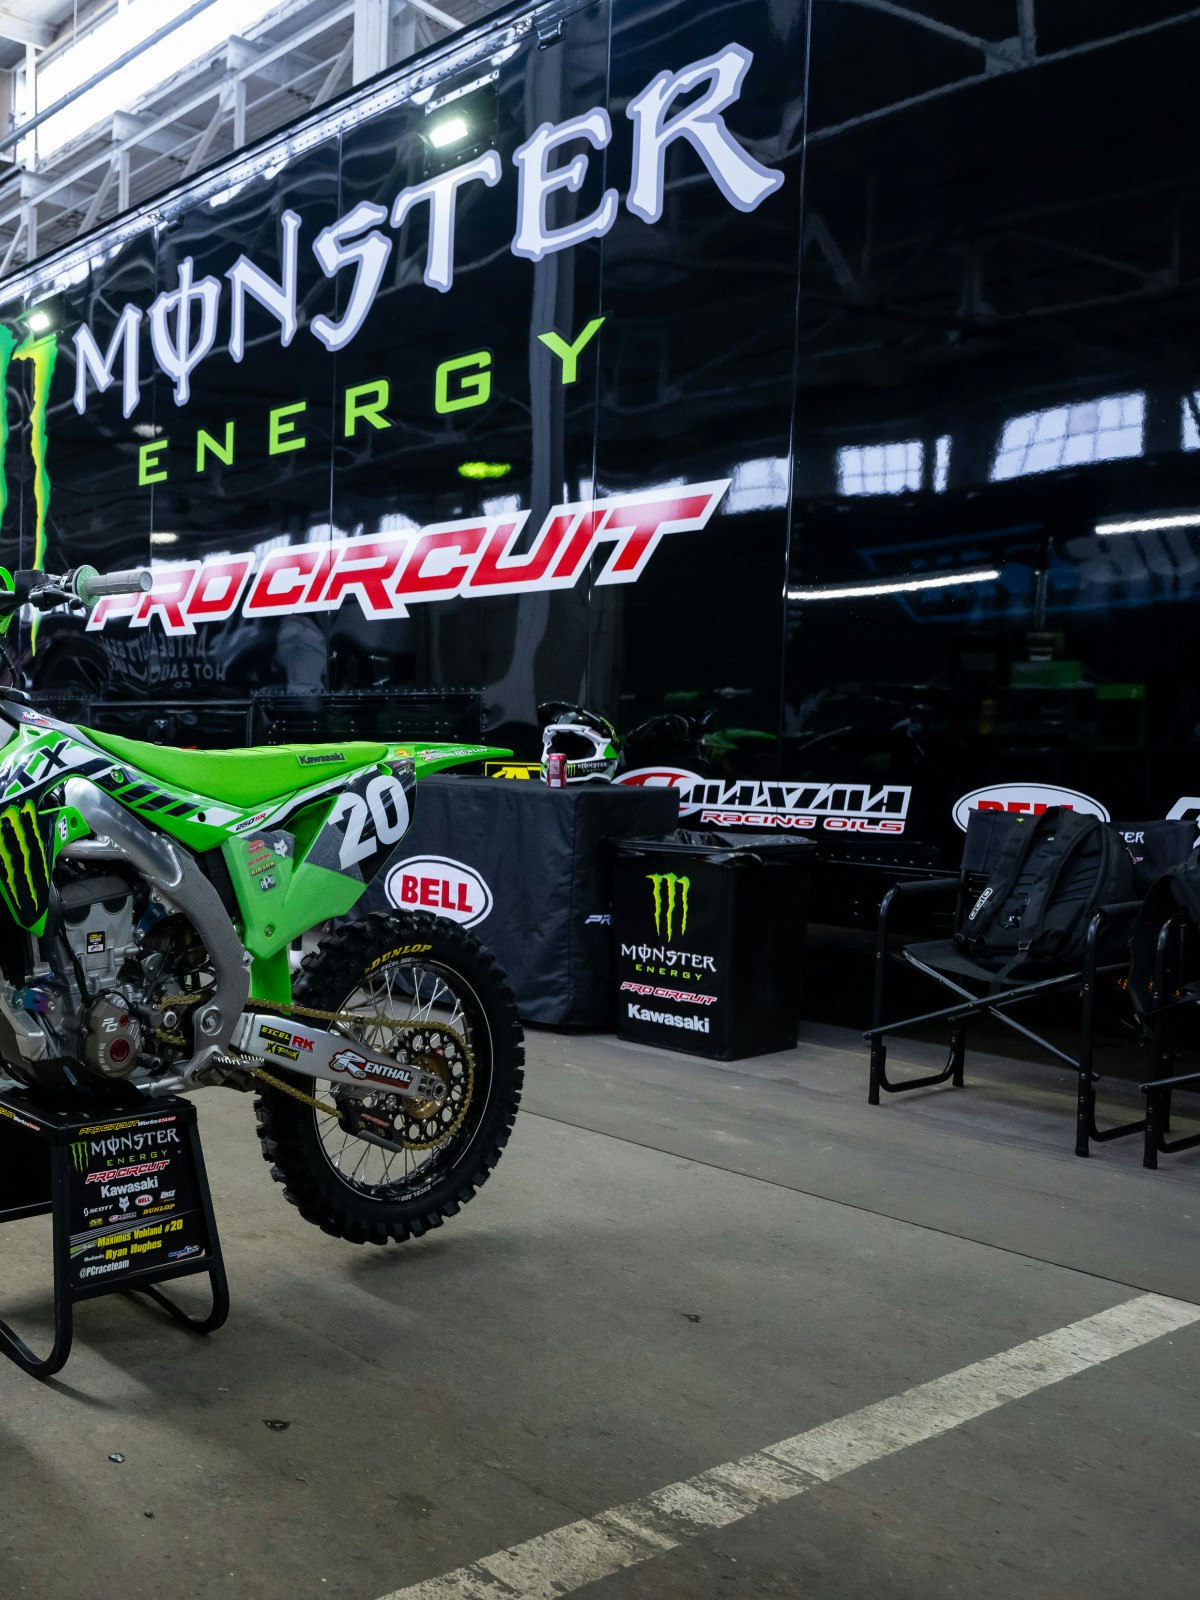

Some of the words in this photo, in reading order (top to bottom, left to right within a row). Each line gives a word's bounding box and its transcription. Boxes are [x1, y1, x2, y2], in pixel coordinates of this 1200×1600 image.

[73, 42, 785, 418] MONSTER
[138, 316, 606, 486] ENERGY
[237, 478, 732, 620] CIRCUIT
[298, 752, 346, 764] Kawasaki
[577, 761, 608, 770] MONSTER
[680, 780, 912, 820] MAXIMA
[327, 774, 410, 871] 20
[824, 816, 906, 835] OILS
[401, 874, 474, 913] BELL
[370, 944, 433, 971] DUNLOP
[620, 944, 717, 972] MONSTER
[635, 964, 703, 981] ENERGY
[620, 981, 654, 996] PRO
[653, 987, 718, 1005] CIRCUIT
[628, 1003, 710, 1034] Kawasaki
[261, 1026, 290, 1040] EXCEL
[291, 1035, 315, 1051] RK
[91, 1128, 180, 1157] MONSTER
[106, 1149, 168, 1167] ENERGY
[85, 1169, 118, 1184] PRO
[115, 1159, 170, 1178] CIRCUIT
[100, 1176, 159, 1198] Kawasaki
[90, 1204, 113, 1213] SCOTT
[143, 1204, 175, 1215] DUNLOP
[97, 1233, 131, 1247] Maximus
[133, 1225, 162, 1239] Vohland
[165, 1219, 184, 1233] #20
[105, 1247, 128, 1260] Ryan
[131, 1240, 162, 1255] Hughes
[80, 1260, 130, 1278] @PCraceteam
